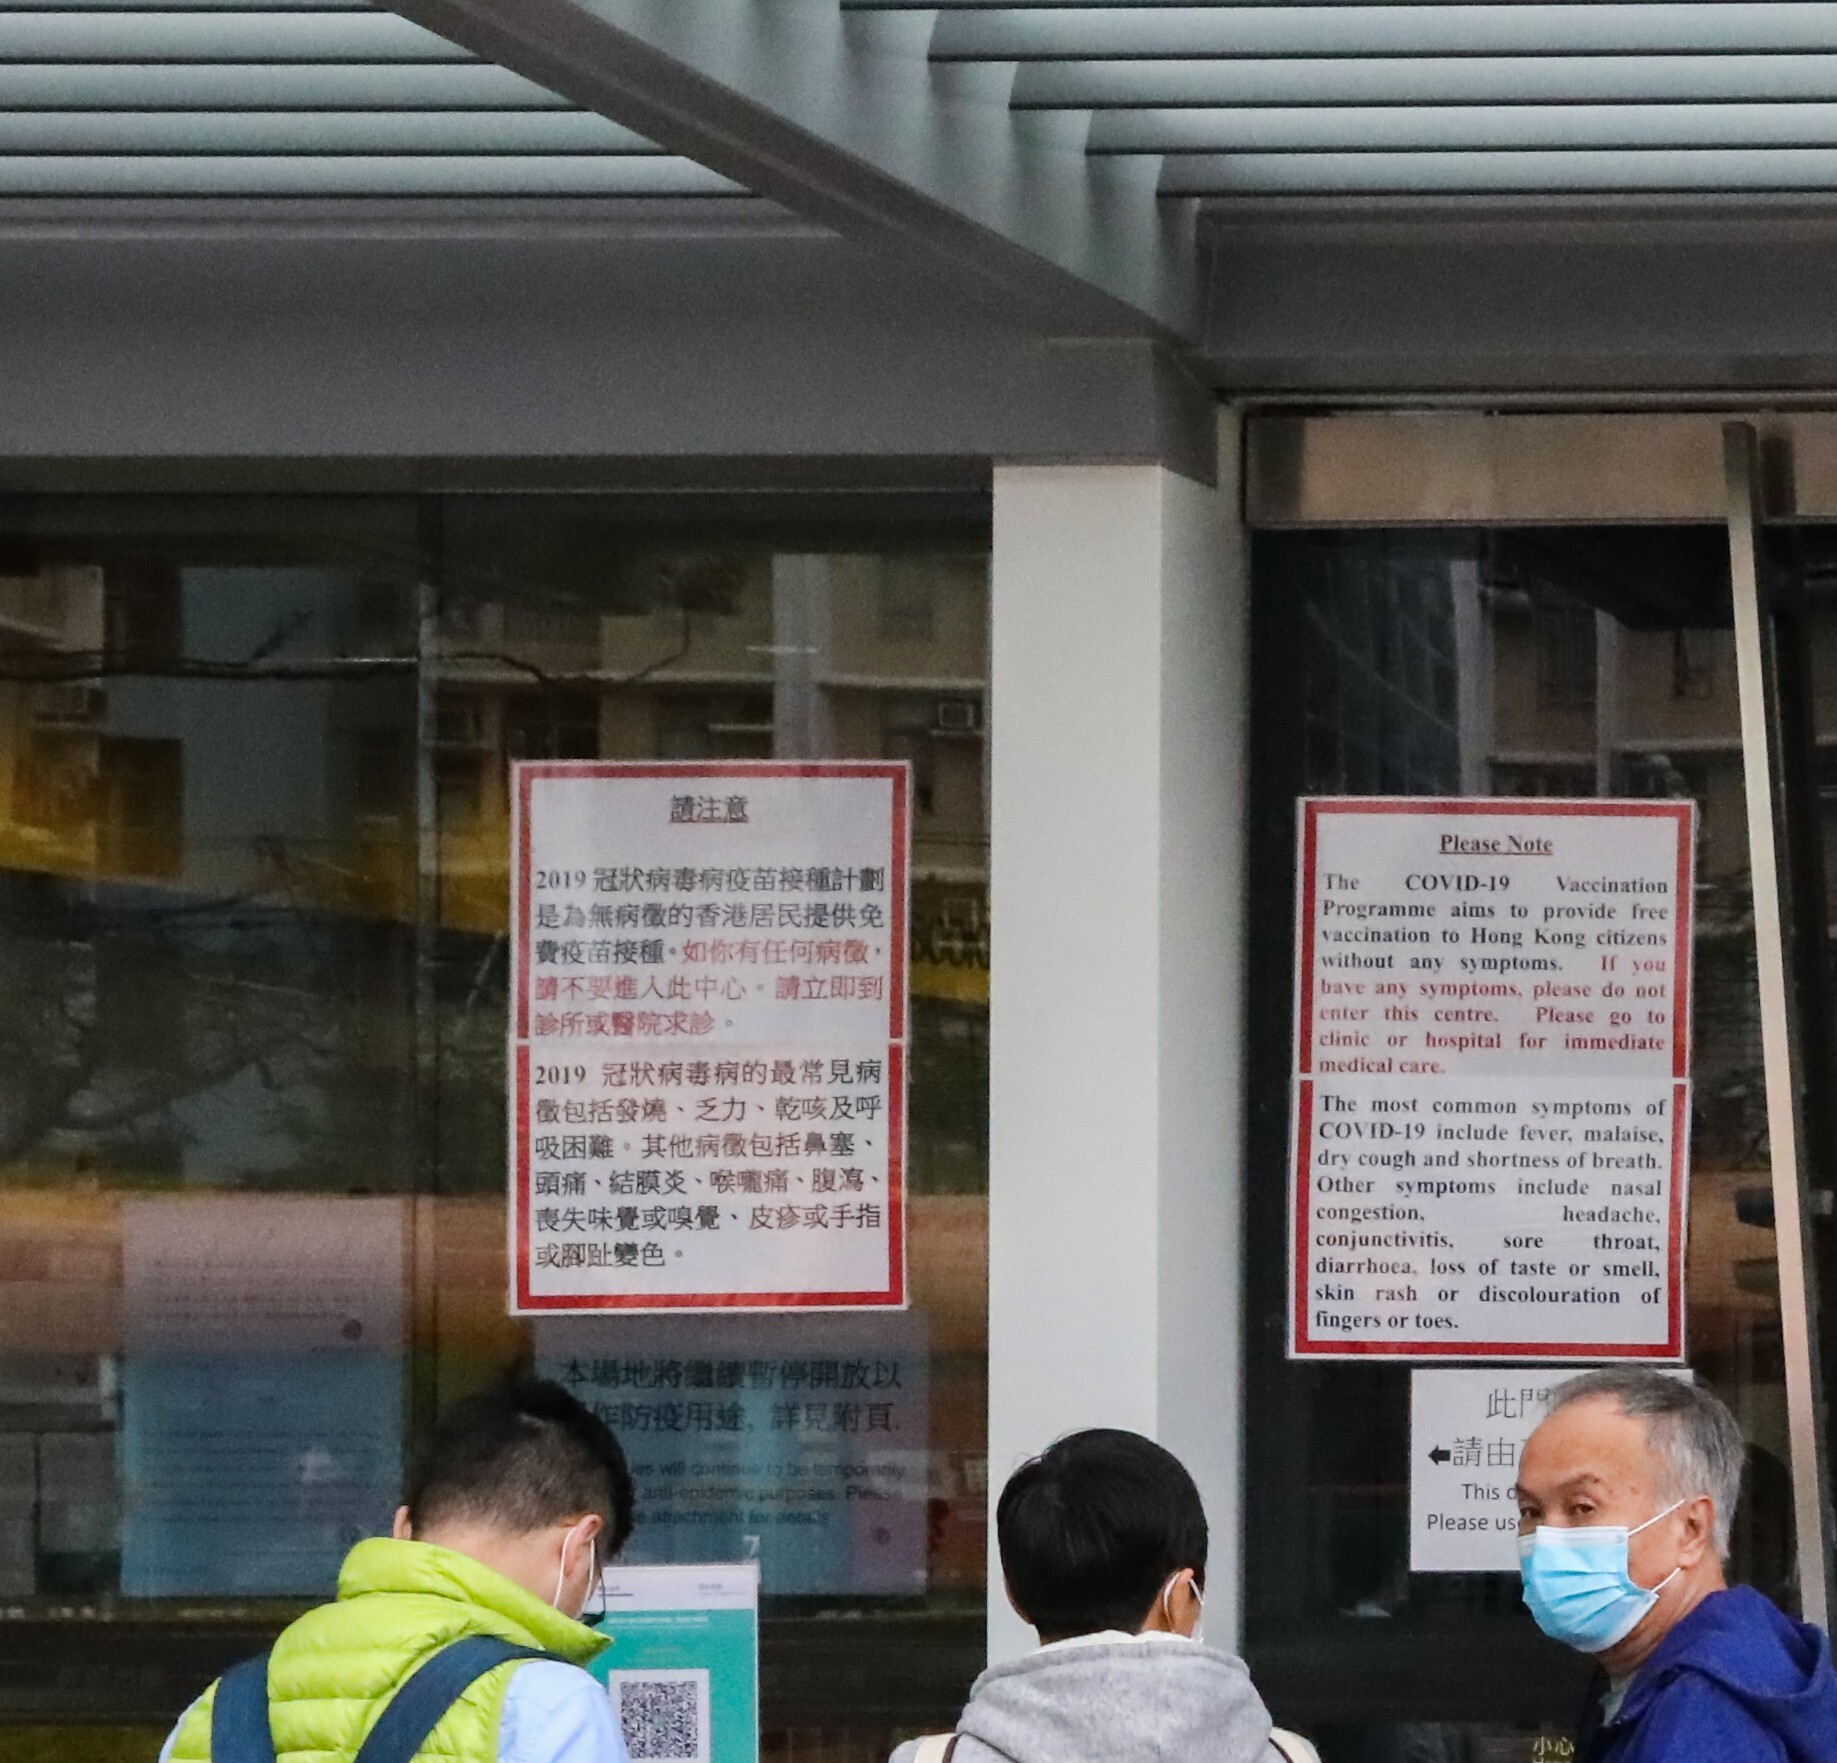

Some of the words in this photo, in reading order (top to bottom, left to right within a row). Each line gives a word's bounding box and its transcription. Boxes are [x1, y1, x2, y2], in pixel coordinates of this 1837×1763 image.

[1439, 834, 1502, 855] Please
[1507, 835, 1553, 856] Note
[1327, 873, 1359, 890] The
[1404, 874, 1510, 892] COVID-19
[1556, 876, 1668, 894] Vaccination
[1323, 899, 1436, 920] Programme
[1450, 901, 1495, 918] aims
[1510, 903, 1529, 918] to
[1543, 903, 1616, 923] provide
[1632, 903, 1666, 920] free
[1322, 926, 1430, 943] vaccination
[1441, 929, 1460, 944] to
[1471, 926, 1523, 948] Hong
[1534, 928, 1585, 949] Kong
[1596, 929, 1667, 946] citizens
[1321, 952, 1394, 969] without
[1410, 957, 1442, 970] any
[1460, 956, 1563, 975] symptoms.
[1601, 955, 1615, 972] If
[1633, 960, 1665, 975] you
[1319, 1057, 1393, 1073] medical
[1399, 1062, 1446, 1074] care.
[1316, 1203, 1425, 1224] congestion,
[1562, 1205, 1661, 1225] headache,
[1316, 1230, 1454, 1251] conjunctivitis,
[1503, 1236, 1544, 1249] sore
[1593, 1233, 1660, 1252] throat,
[1315, 1310, 1381, 1332] fingers
[1387, 1316, 1409, 1329] or
[1415, 1313, 1459, 1329] toes.
[1452, 1435, 1523, 1469] 請由
[1461, 1483, 1500, 1501] This
[1427, 1513, 1489, 1531] Please
